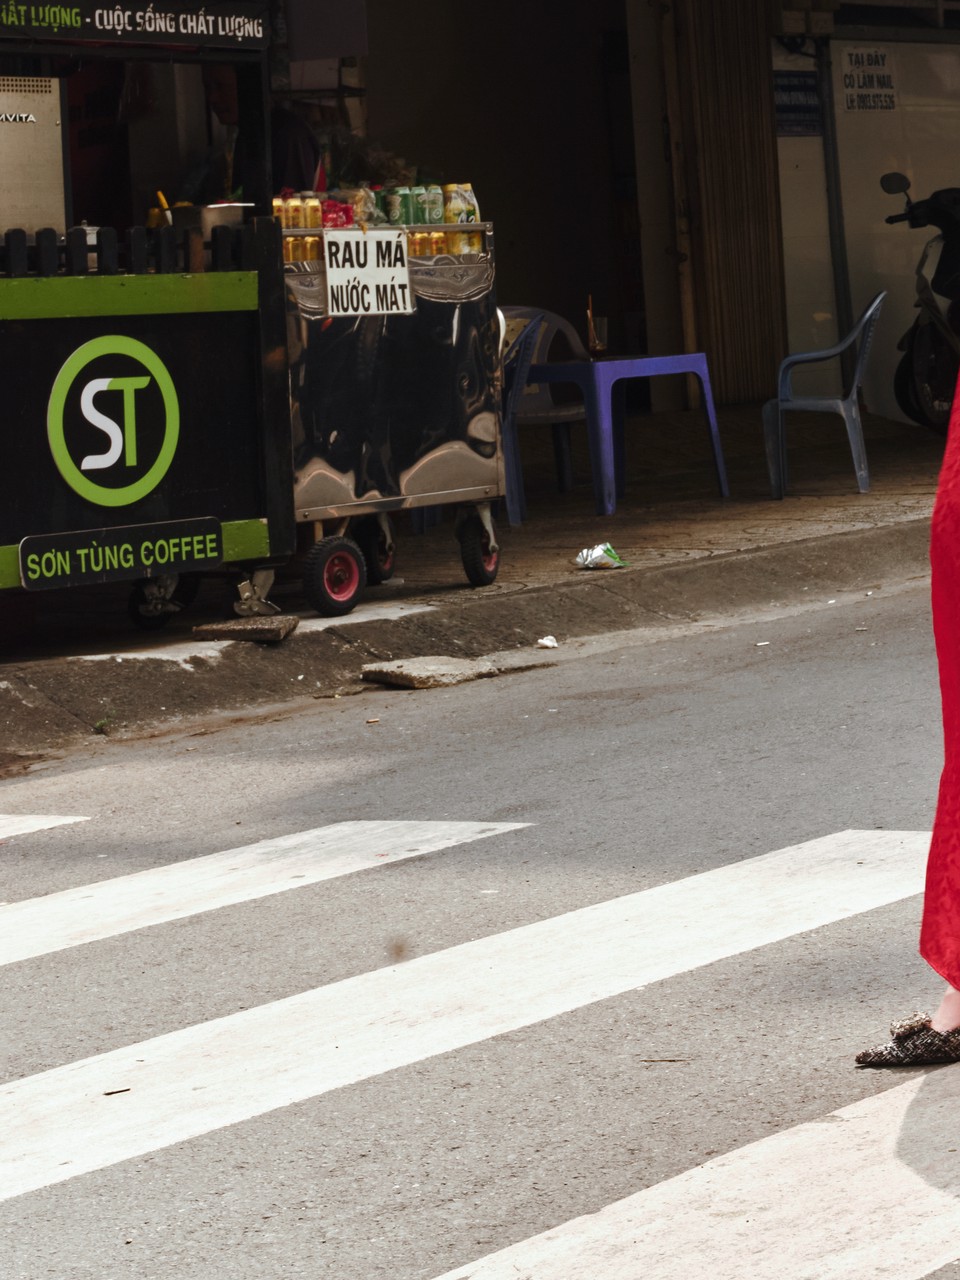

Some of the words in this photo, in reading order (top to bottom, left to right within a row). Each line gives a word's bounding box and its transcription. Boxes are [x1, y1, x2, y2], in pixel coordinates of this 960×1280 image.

[31, 5, 81, 32] LƯỢNG
[95, 5, 132, 35] CUỘC
[136, 3, 176, 32] SỐNG
[179, 7, 215, 35] CHẤT
[219, 15, 263, 41] LƯỢNG
[877, 74, 894, 90] NAIL
[327, 240, 368, 269] RAU
[376, 232, 406, 269] MÁ
[330, 276, 371, 313] NƯỚC
[375, 275, 408, 312] MÁT
[80, 376, 151, 470] ST
[27, 549, 70, 579] SƠN
[76, 541, 134, 573] TÙNG
[140, 534, 219, 566] COFFEE
